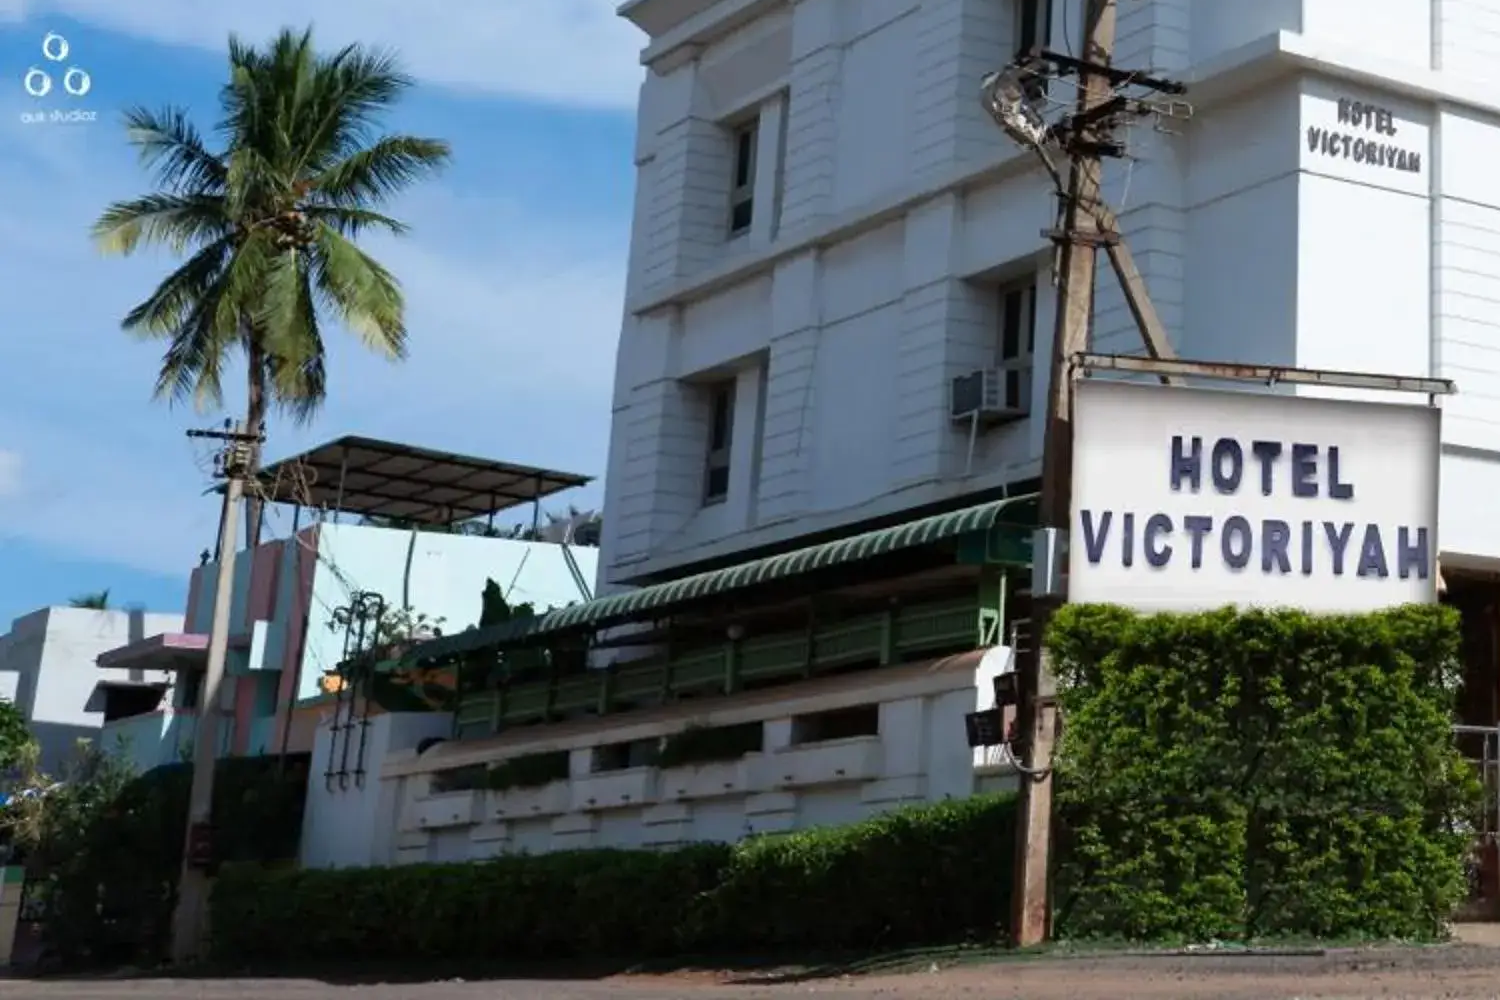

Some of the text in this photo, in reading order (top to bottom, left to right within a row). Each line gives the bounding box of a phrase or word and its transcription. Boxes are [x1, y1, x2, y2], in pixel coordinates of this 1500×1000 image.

[1336, 97, 1398, 137] HOTEL
[1170, 434, 1355, 500] HOTEL
[1080, 508, 1430, 580] VICTORIYAH
